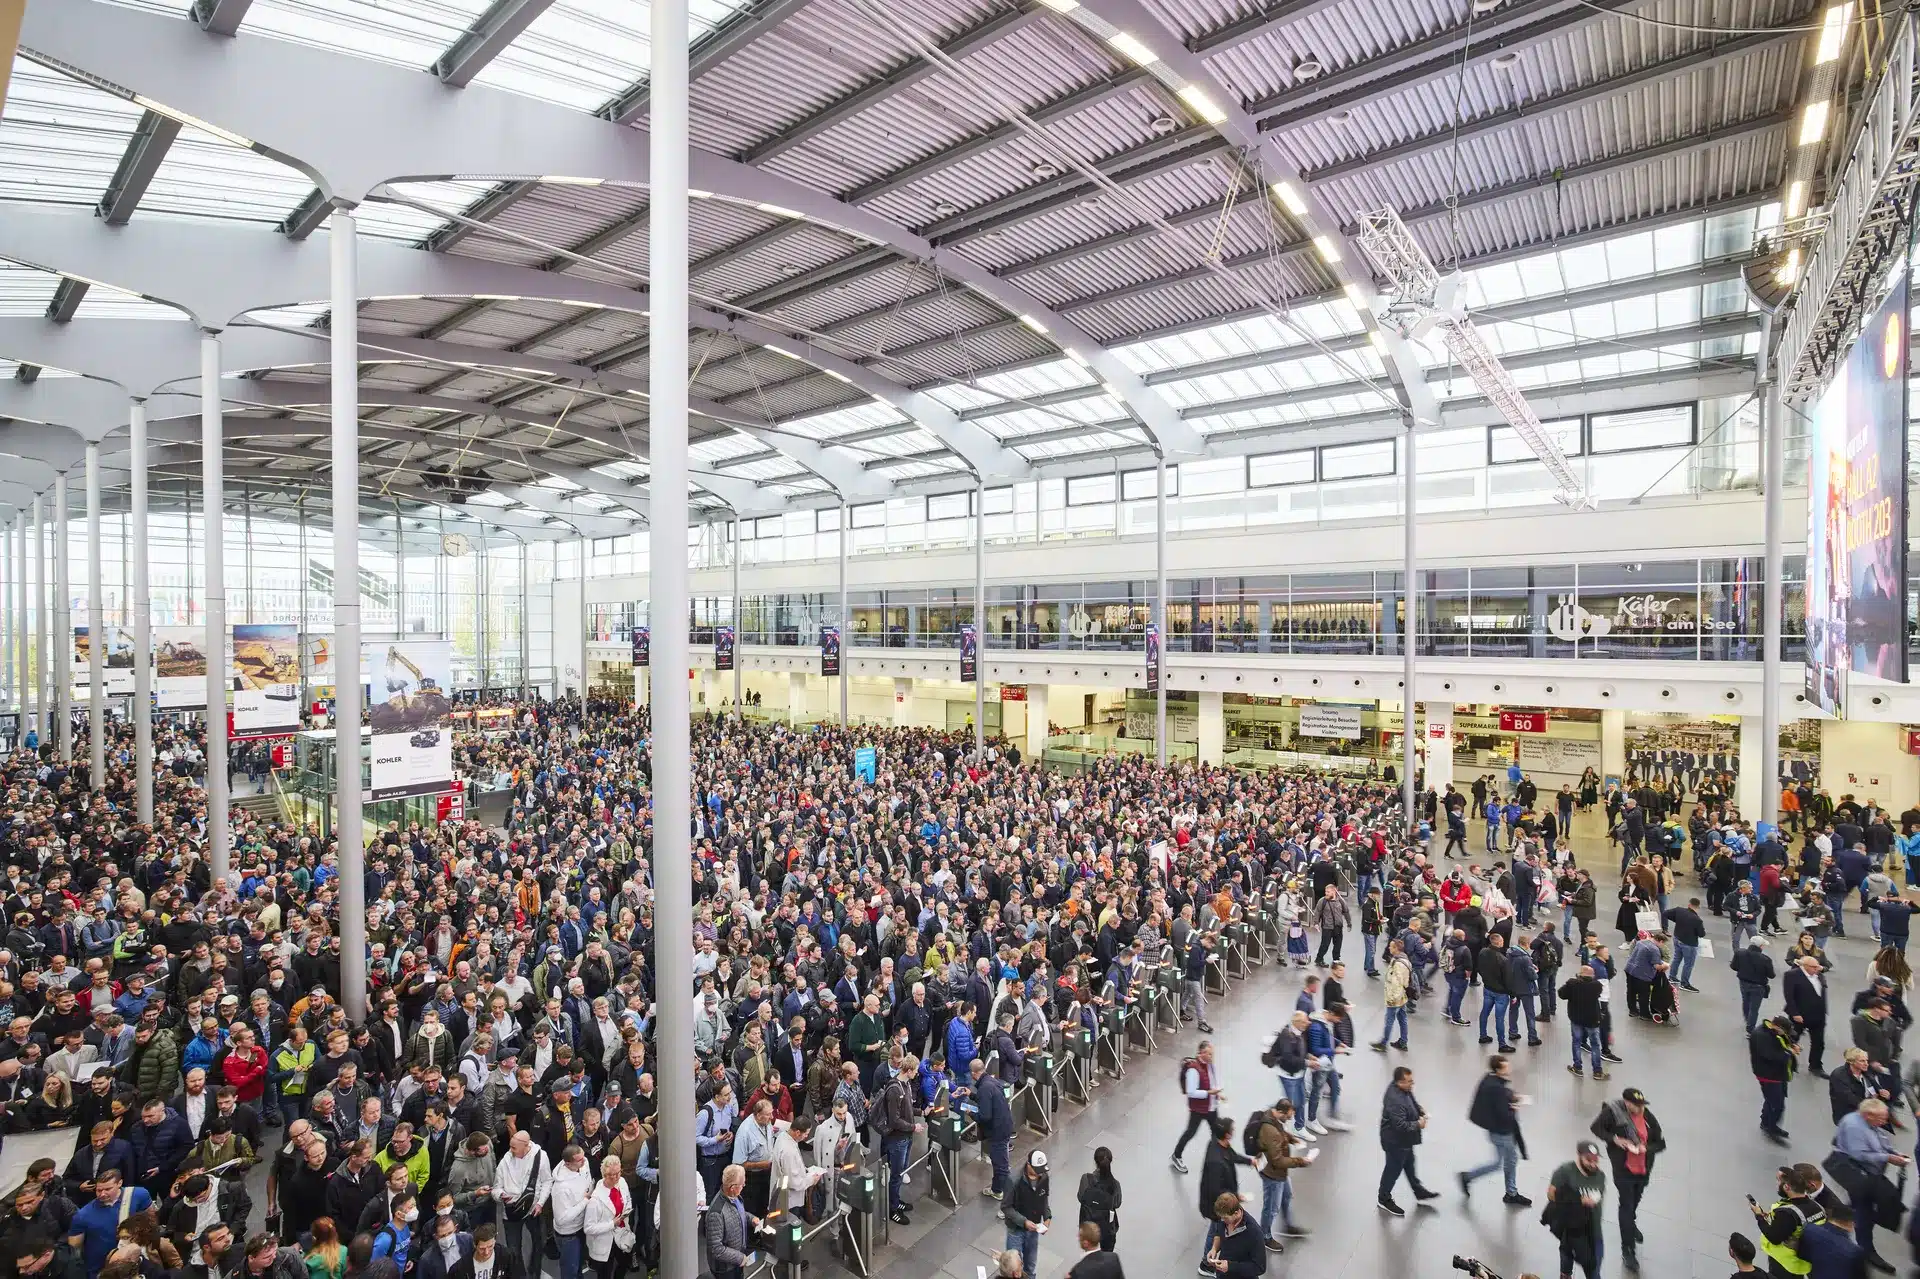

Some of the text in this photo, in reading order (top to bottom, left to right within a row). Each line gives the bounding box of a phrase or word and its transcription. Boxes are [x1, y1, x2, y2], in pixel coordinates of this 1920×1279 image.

[1873, 496, 1891, 540] 203
[1618, 594, 1681, 619] Käfer
[1667, 617, 1736, 630] am See
[1459, 722, 1498, 730] SUPERMARKE
[376, 756, 402, 764] KOHLER
